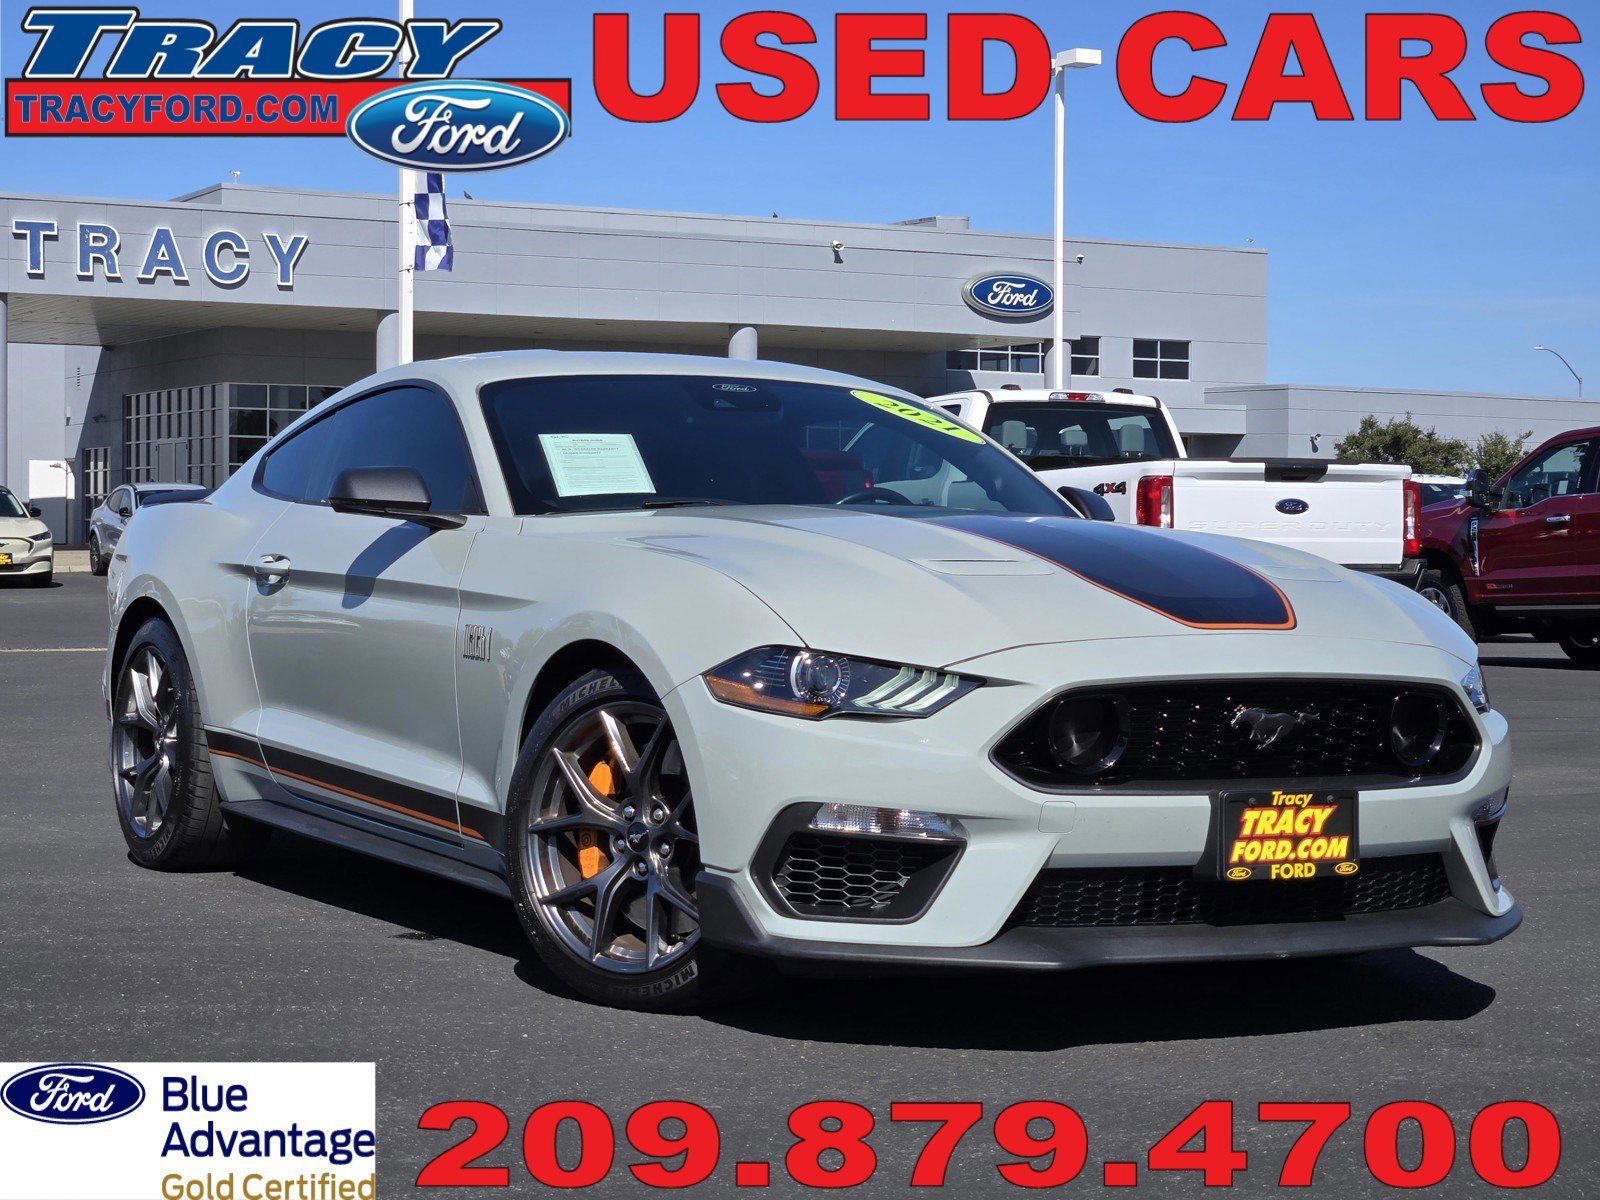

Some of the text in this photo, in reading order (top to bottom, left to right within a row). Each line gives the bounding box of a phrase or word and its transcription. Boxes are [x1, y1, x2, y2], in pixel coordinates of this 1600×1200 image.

[12, 220, 309, 290] TRACY
[987, 280, 1039, 306] Ford
[874, 399, 961, 431] 2021
[1271, 791, 1313, 808] Tracy
[1240, 805, 1337, 837] TRACY
[1230, 836, 1349, 864] FORD.COM
[1271, 862, 1316, 879] FORD
